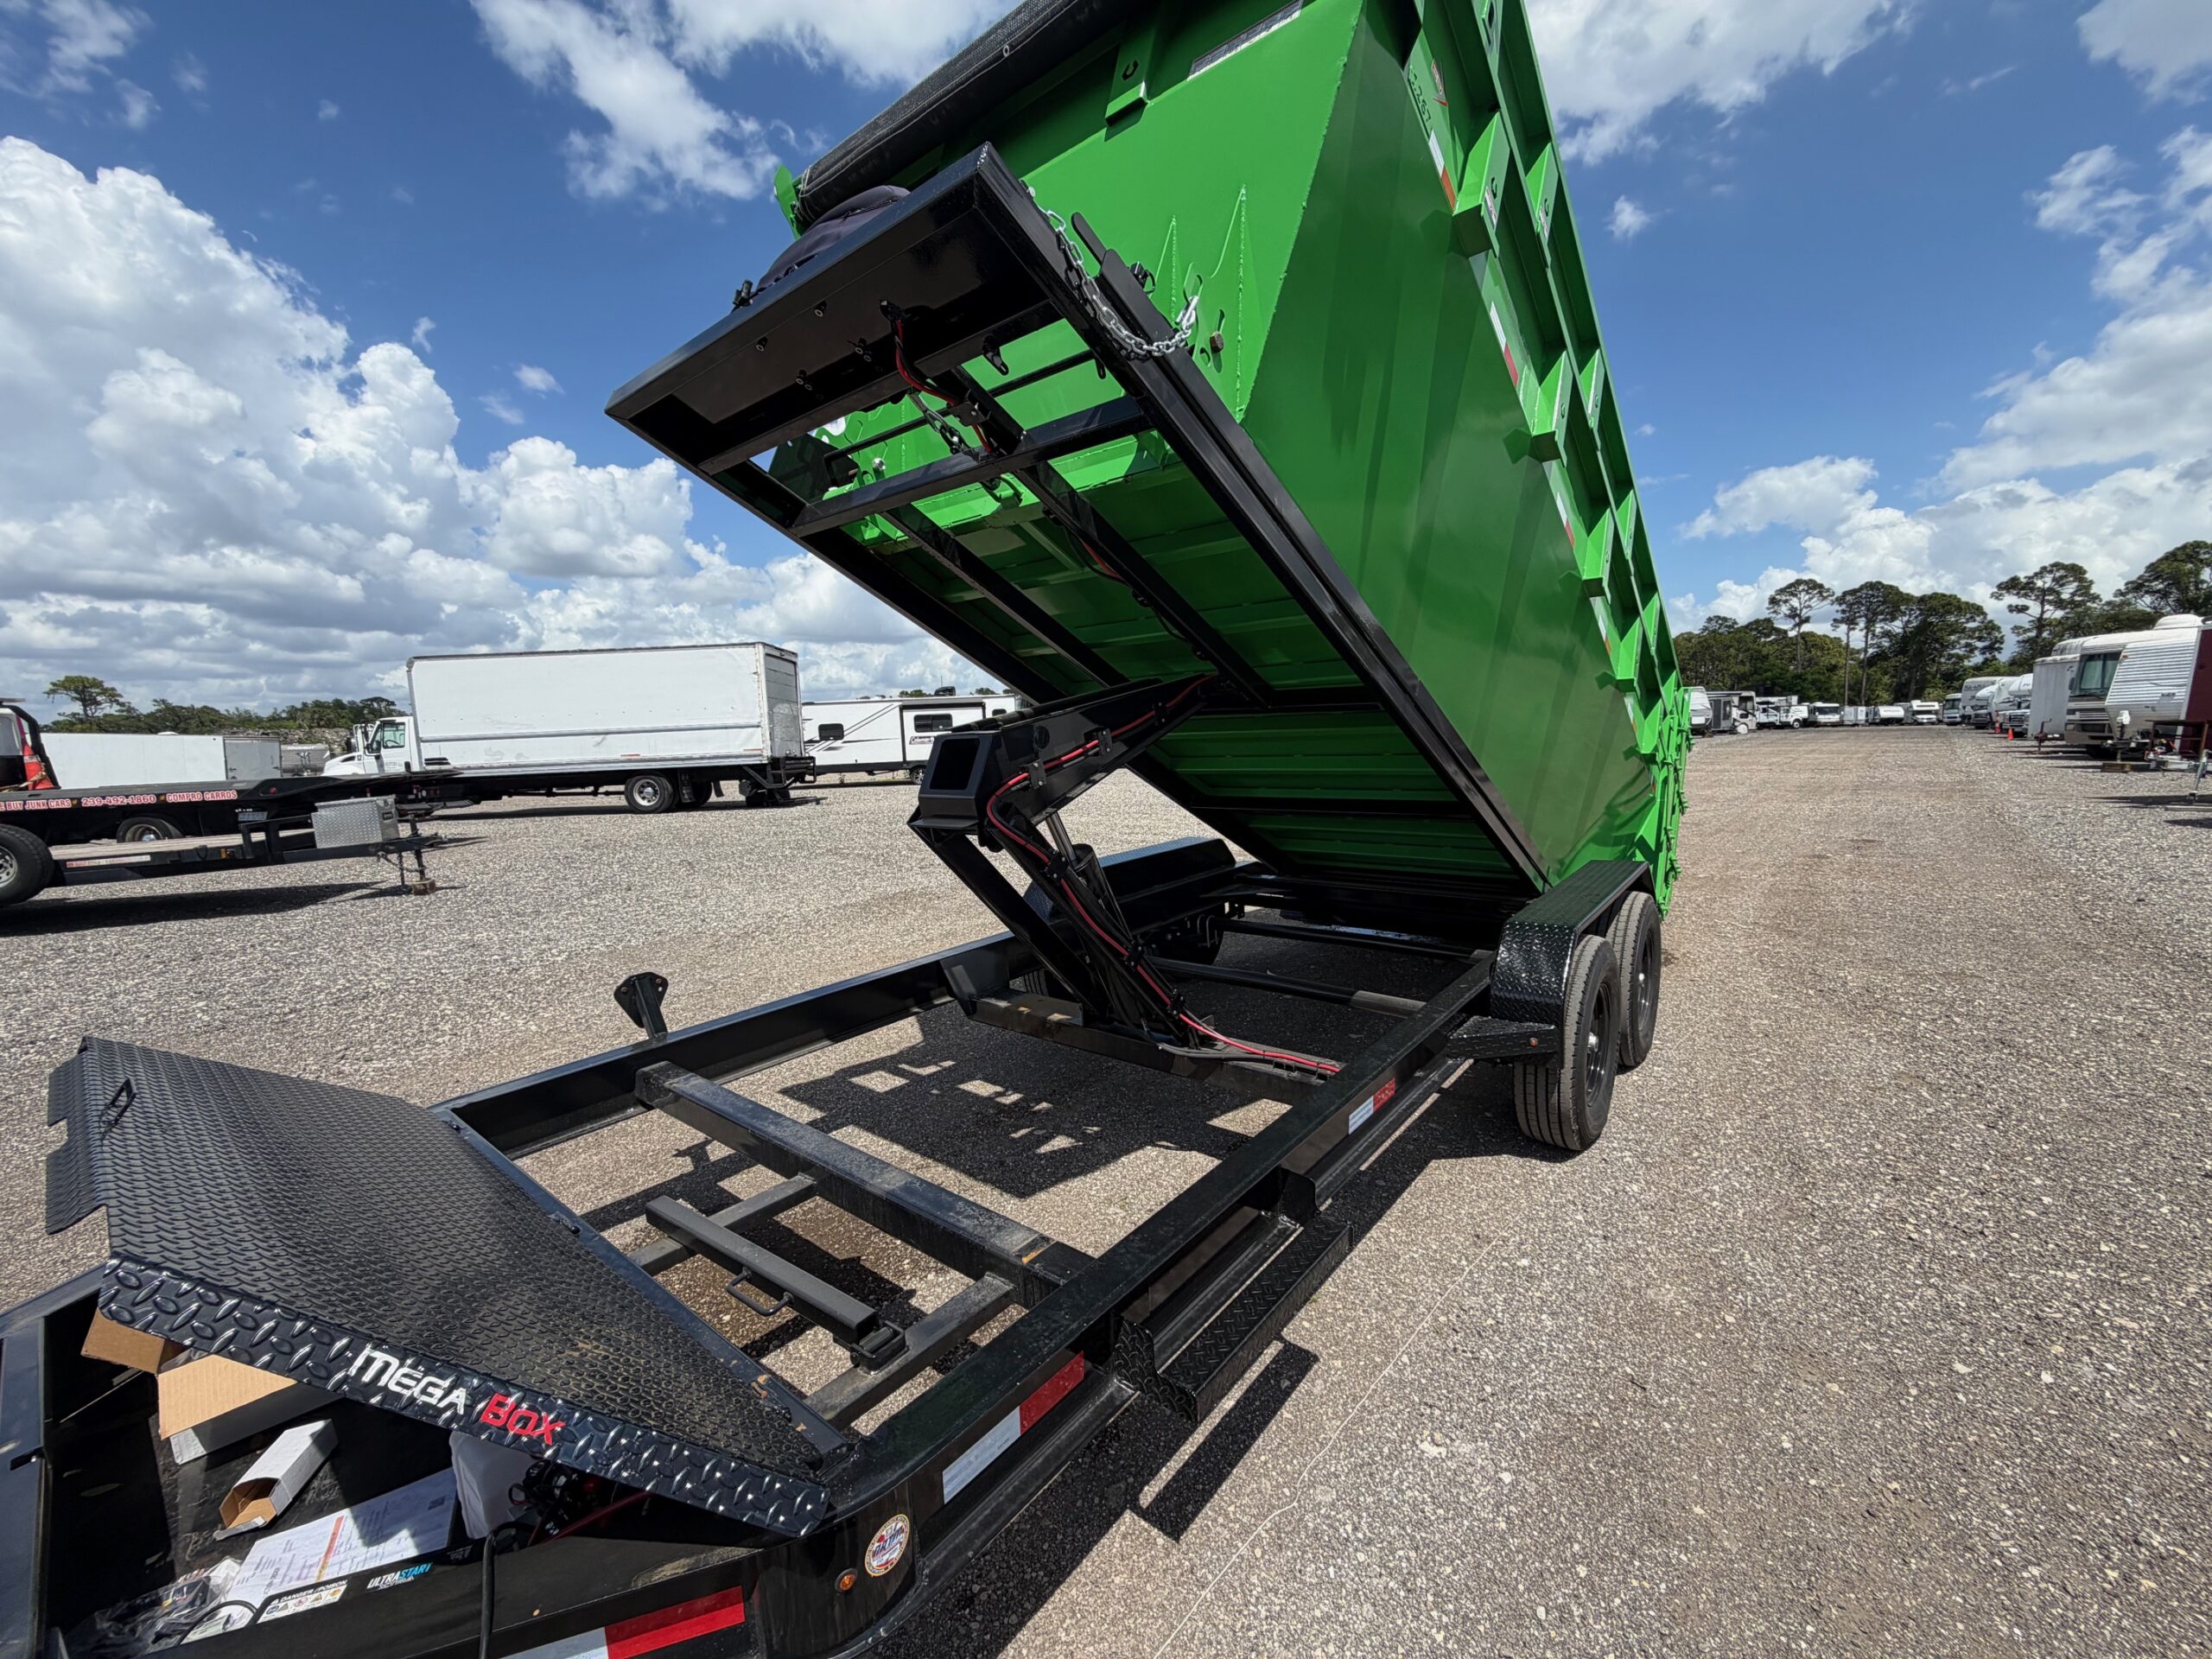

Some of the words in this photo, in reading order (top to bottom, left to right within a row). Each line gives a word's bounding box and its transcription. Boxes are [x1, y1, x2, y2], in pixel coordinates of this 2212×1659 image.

[81, 794, 156, 807] 239-492-1860
[166, 791, 203, 803] COMPRO
[203, 790, 238, 801] CARROS
[0, 801, 5, 811] E
[6, 800, 23, 810] BUY
[25, 799, 48, 810] JUNK
[48, 798, 72, 809] CARS
